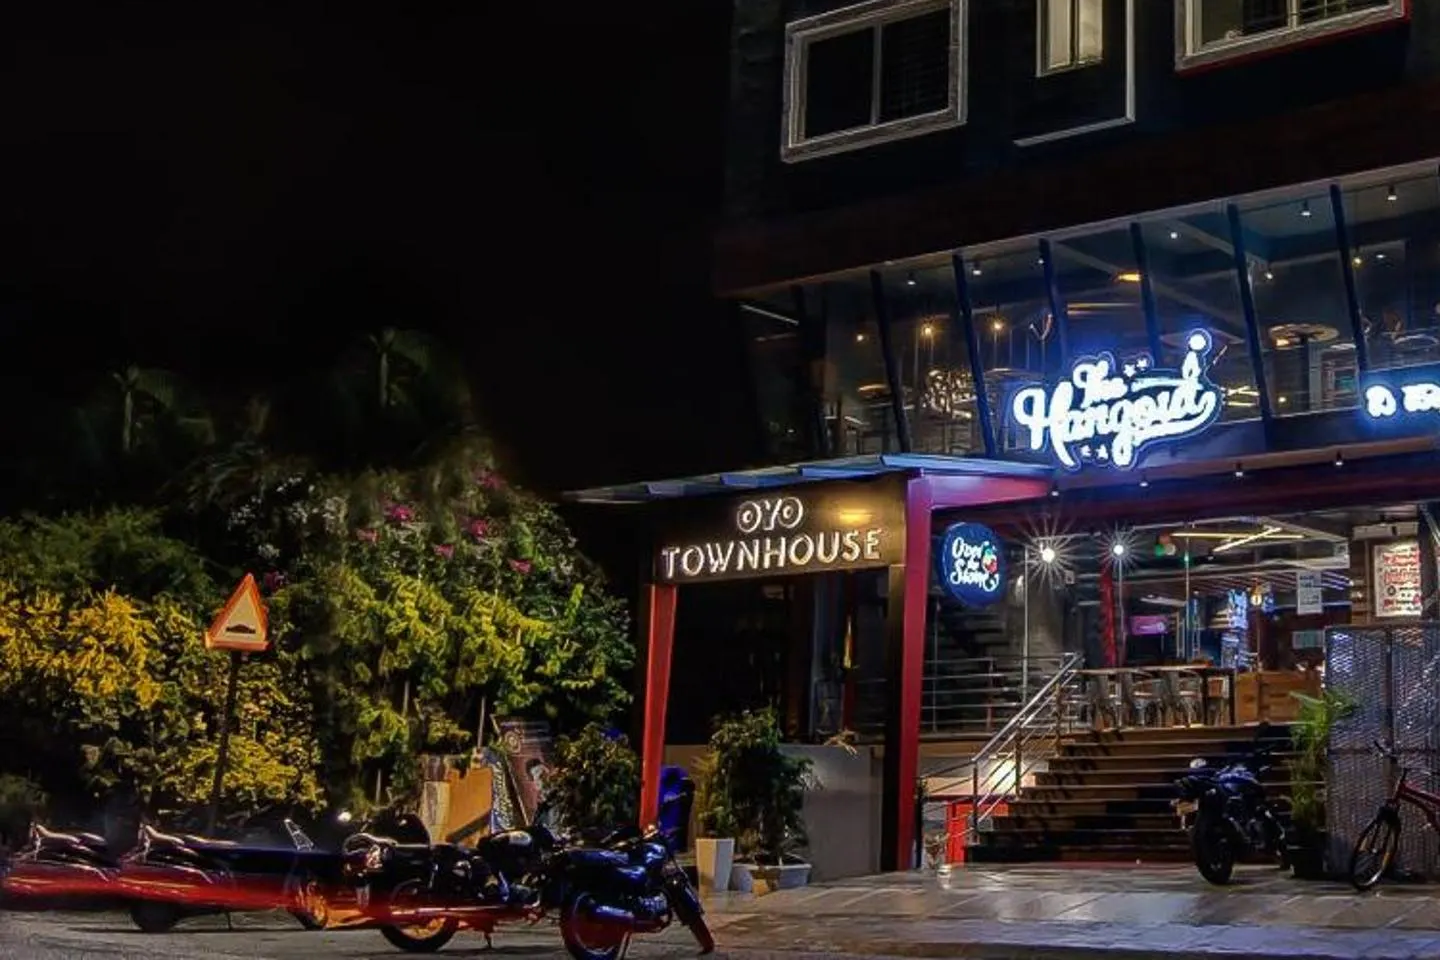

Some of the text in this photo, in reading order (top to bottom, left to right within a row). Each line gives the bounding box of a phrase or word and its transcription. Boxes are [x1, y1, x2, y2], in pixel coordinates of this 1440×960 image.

[1013, 334, 1217, 467] Hangout
[737, 496, 803, 533] OYO
[661, 528, 882, 580] TOWNHOUSE
